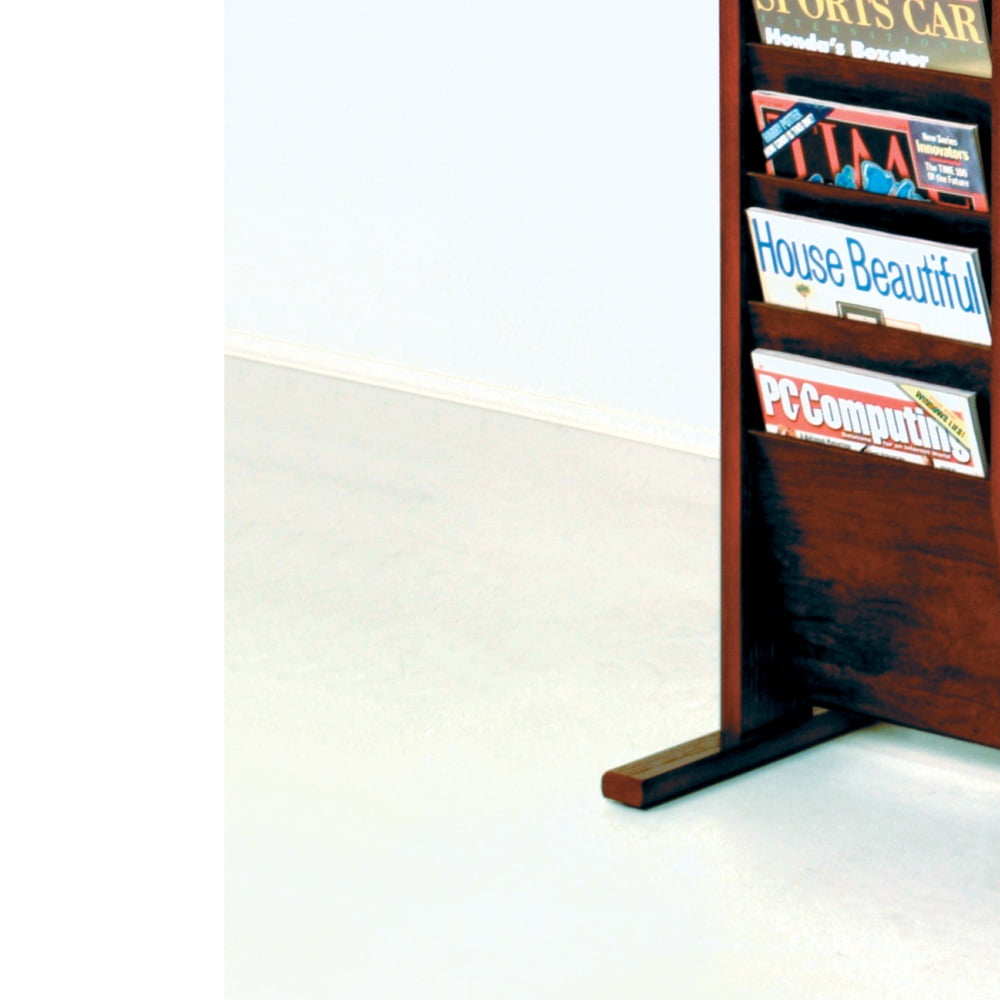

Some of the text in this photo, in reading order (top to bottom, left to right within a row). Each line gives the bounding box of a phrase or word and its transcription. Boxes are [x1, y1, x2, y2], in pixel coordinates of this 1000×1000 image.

[765, 26, 929, 68] Honda's Boxster
[915, 139, 970, 161] Innovators
[752, 218, 982, 316] House Beautiful
